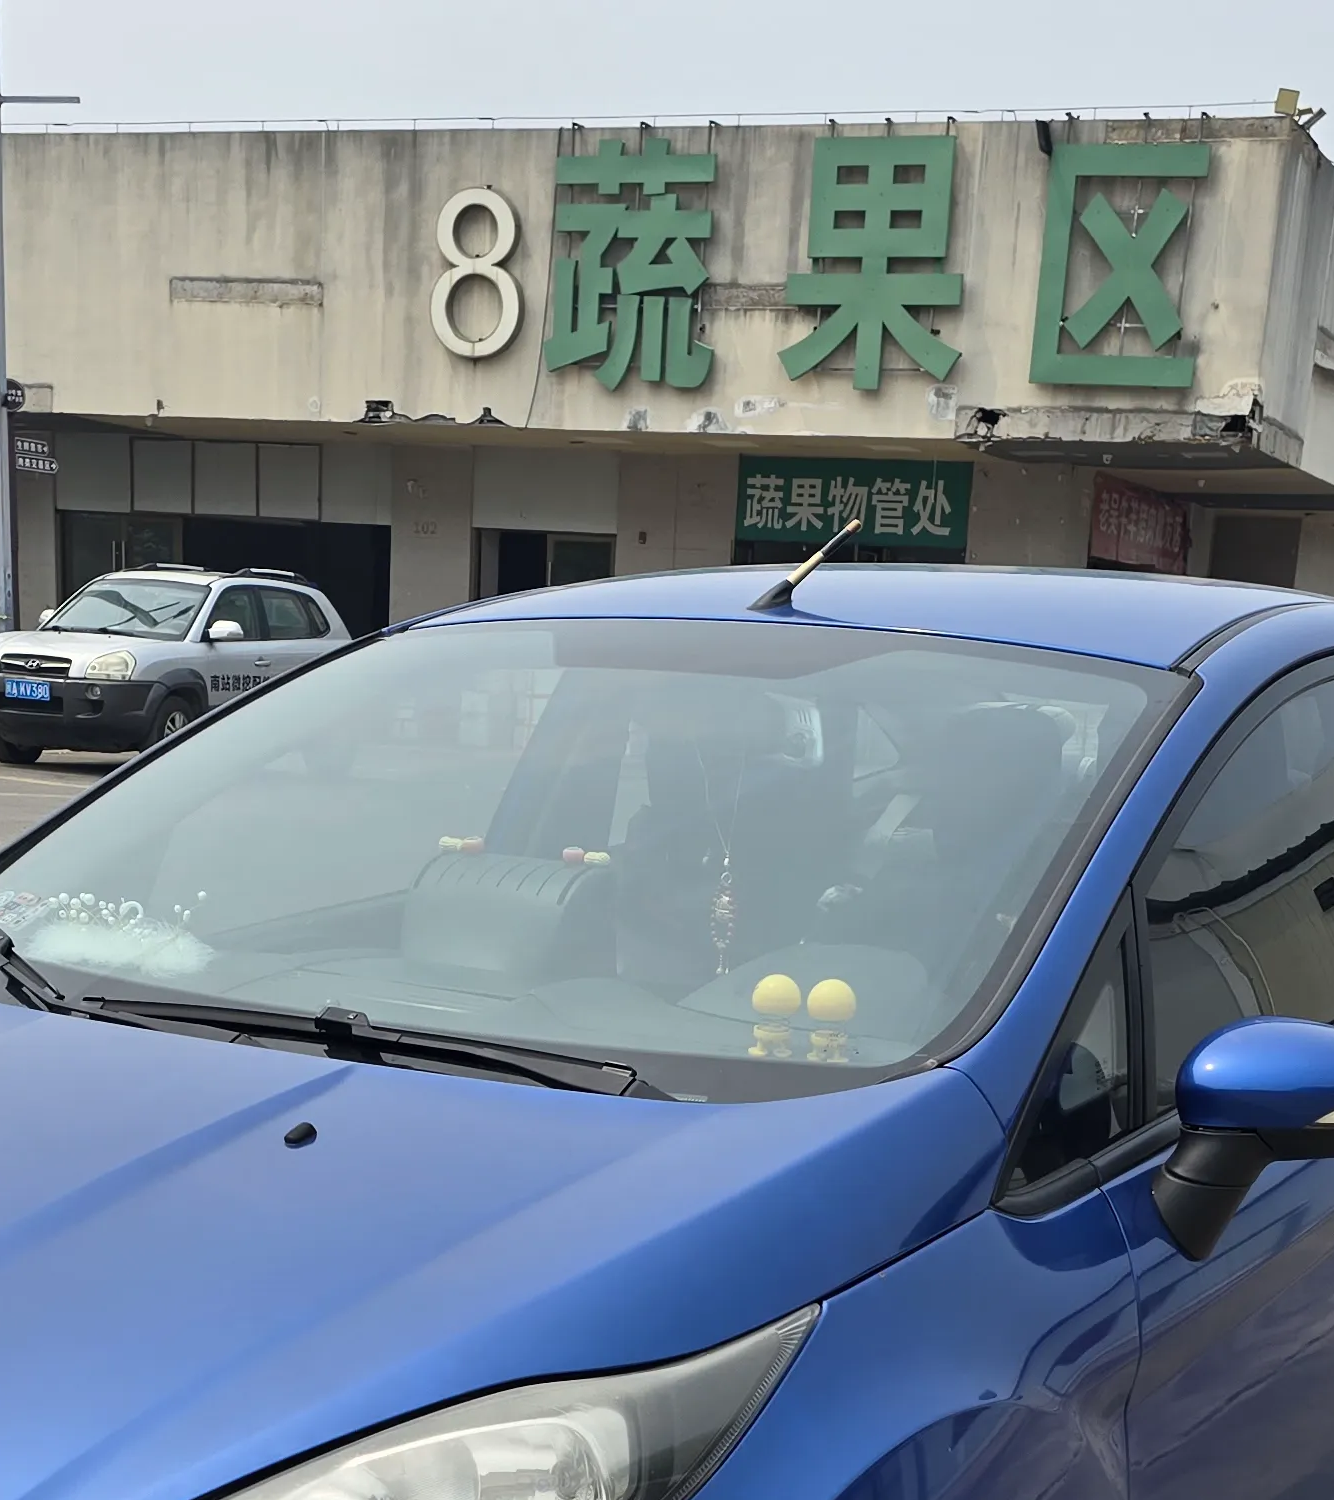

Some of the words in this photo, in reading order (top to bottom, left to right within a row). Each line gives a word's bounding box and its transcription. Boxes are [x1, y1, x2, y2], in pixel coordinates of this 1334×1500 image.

[429, 186, 524, 360] 8
[544, 134, 1211, 393] 蔬果区
[743, 472, 952, 537] 蔬果物管处
[210, 674, 270, 693] 南站微挖配
